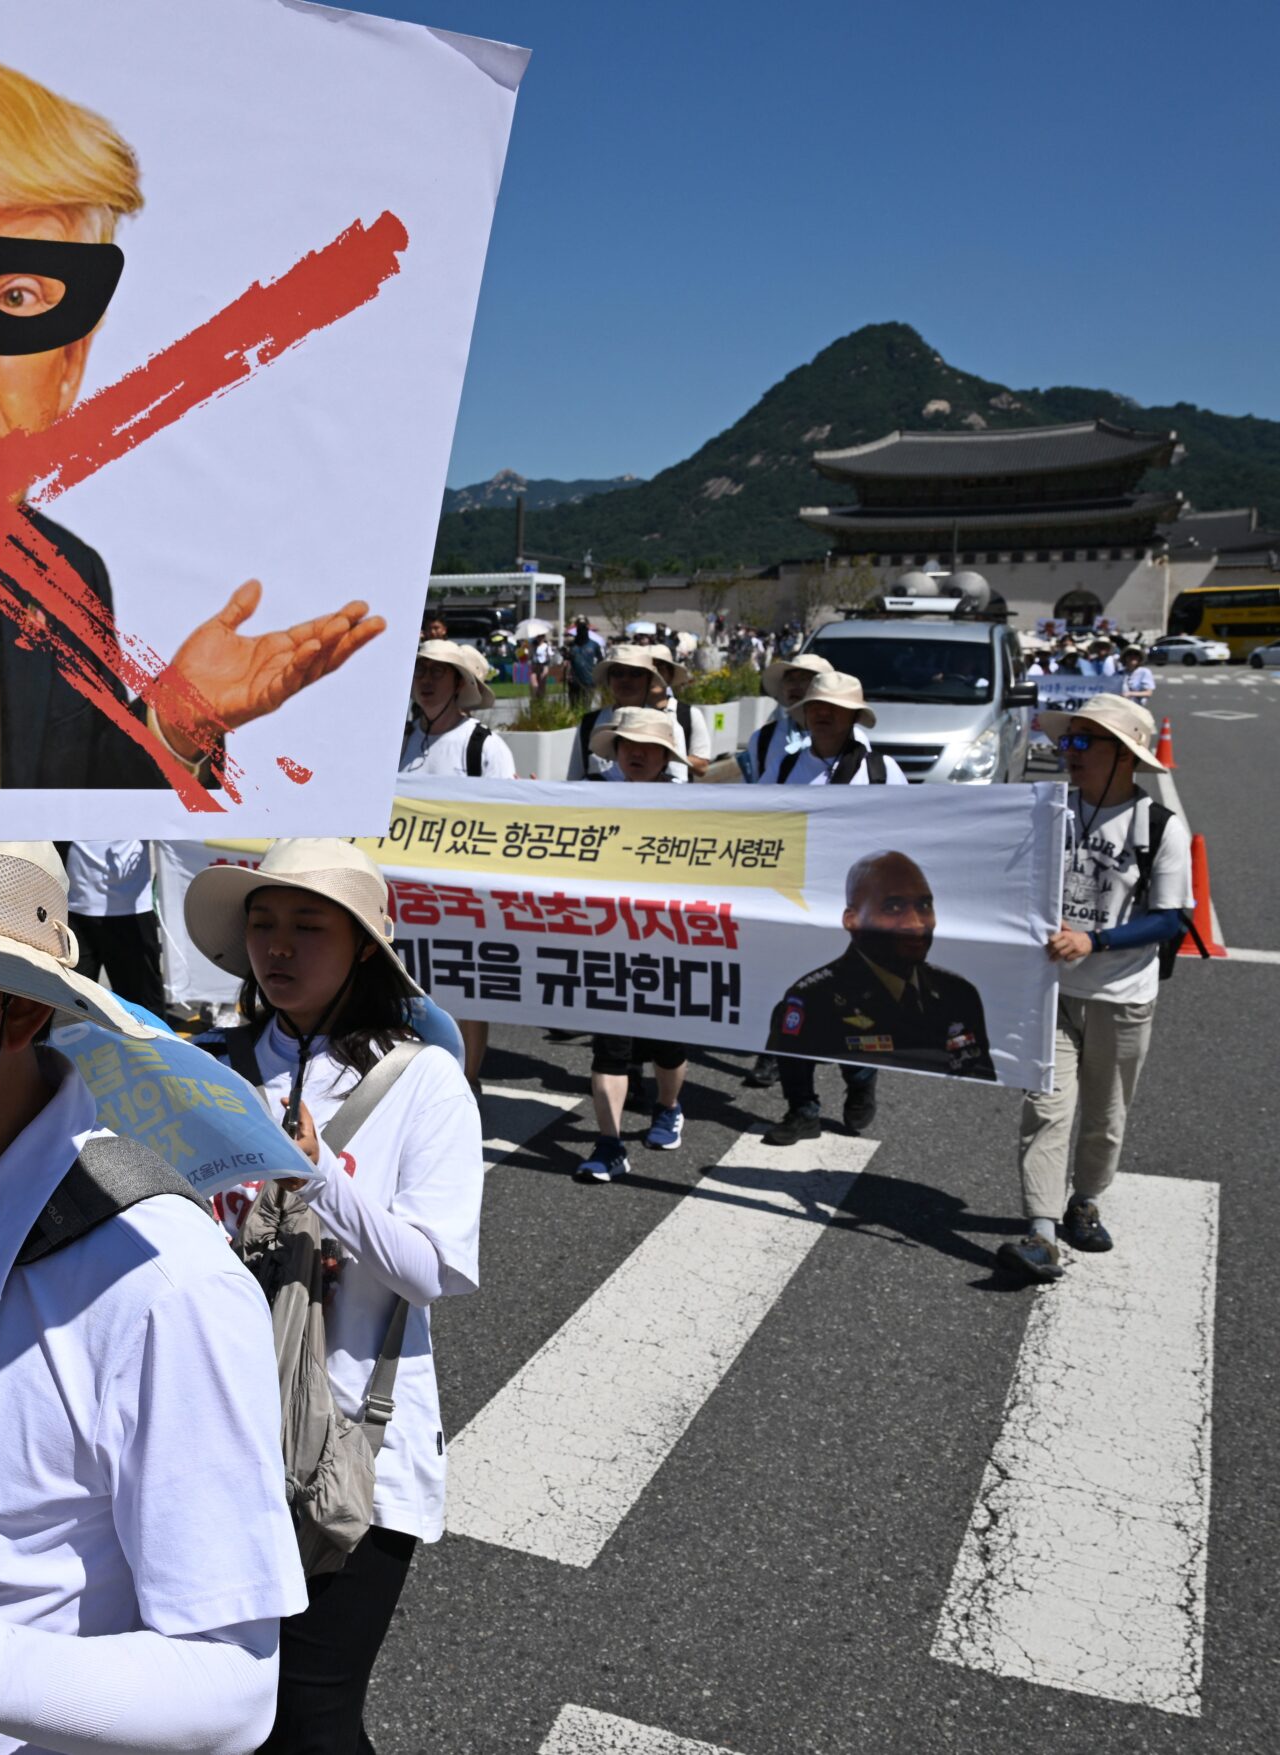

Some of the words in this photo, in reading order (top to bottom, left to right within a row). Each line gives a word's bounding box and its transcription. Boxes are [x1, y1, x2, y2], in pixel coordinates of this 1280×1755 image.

[378, 816, 417, 850] 이
[419, 817, 446, 854] 떠
[445, 819, 497, 856] 있는
[718, 839, 785, 868] 사령관
[386, 879, 486, 928] 중국
[490, 890, 740, 949] 전초기지화
[536, 946, 741, 1024] 규탄한다!
